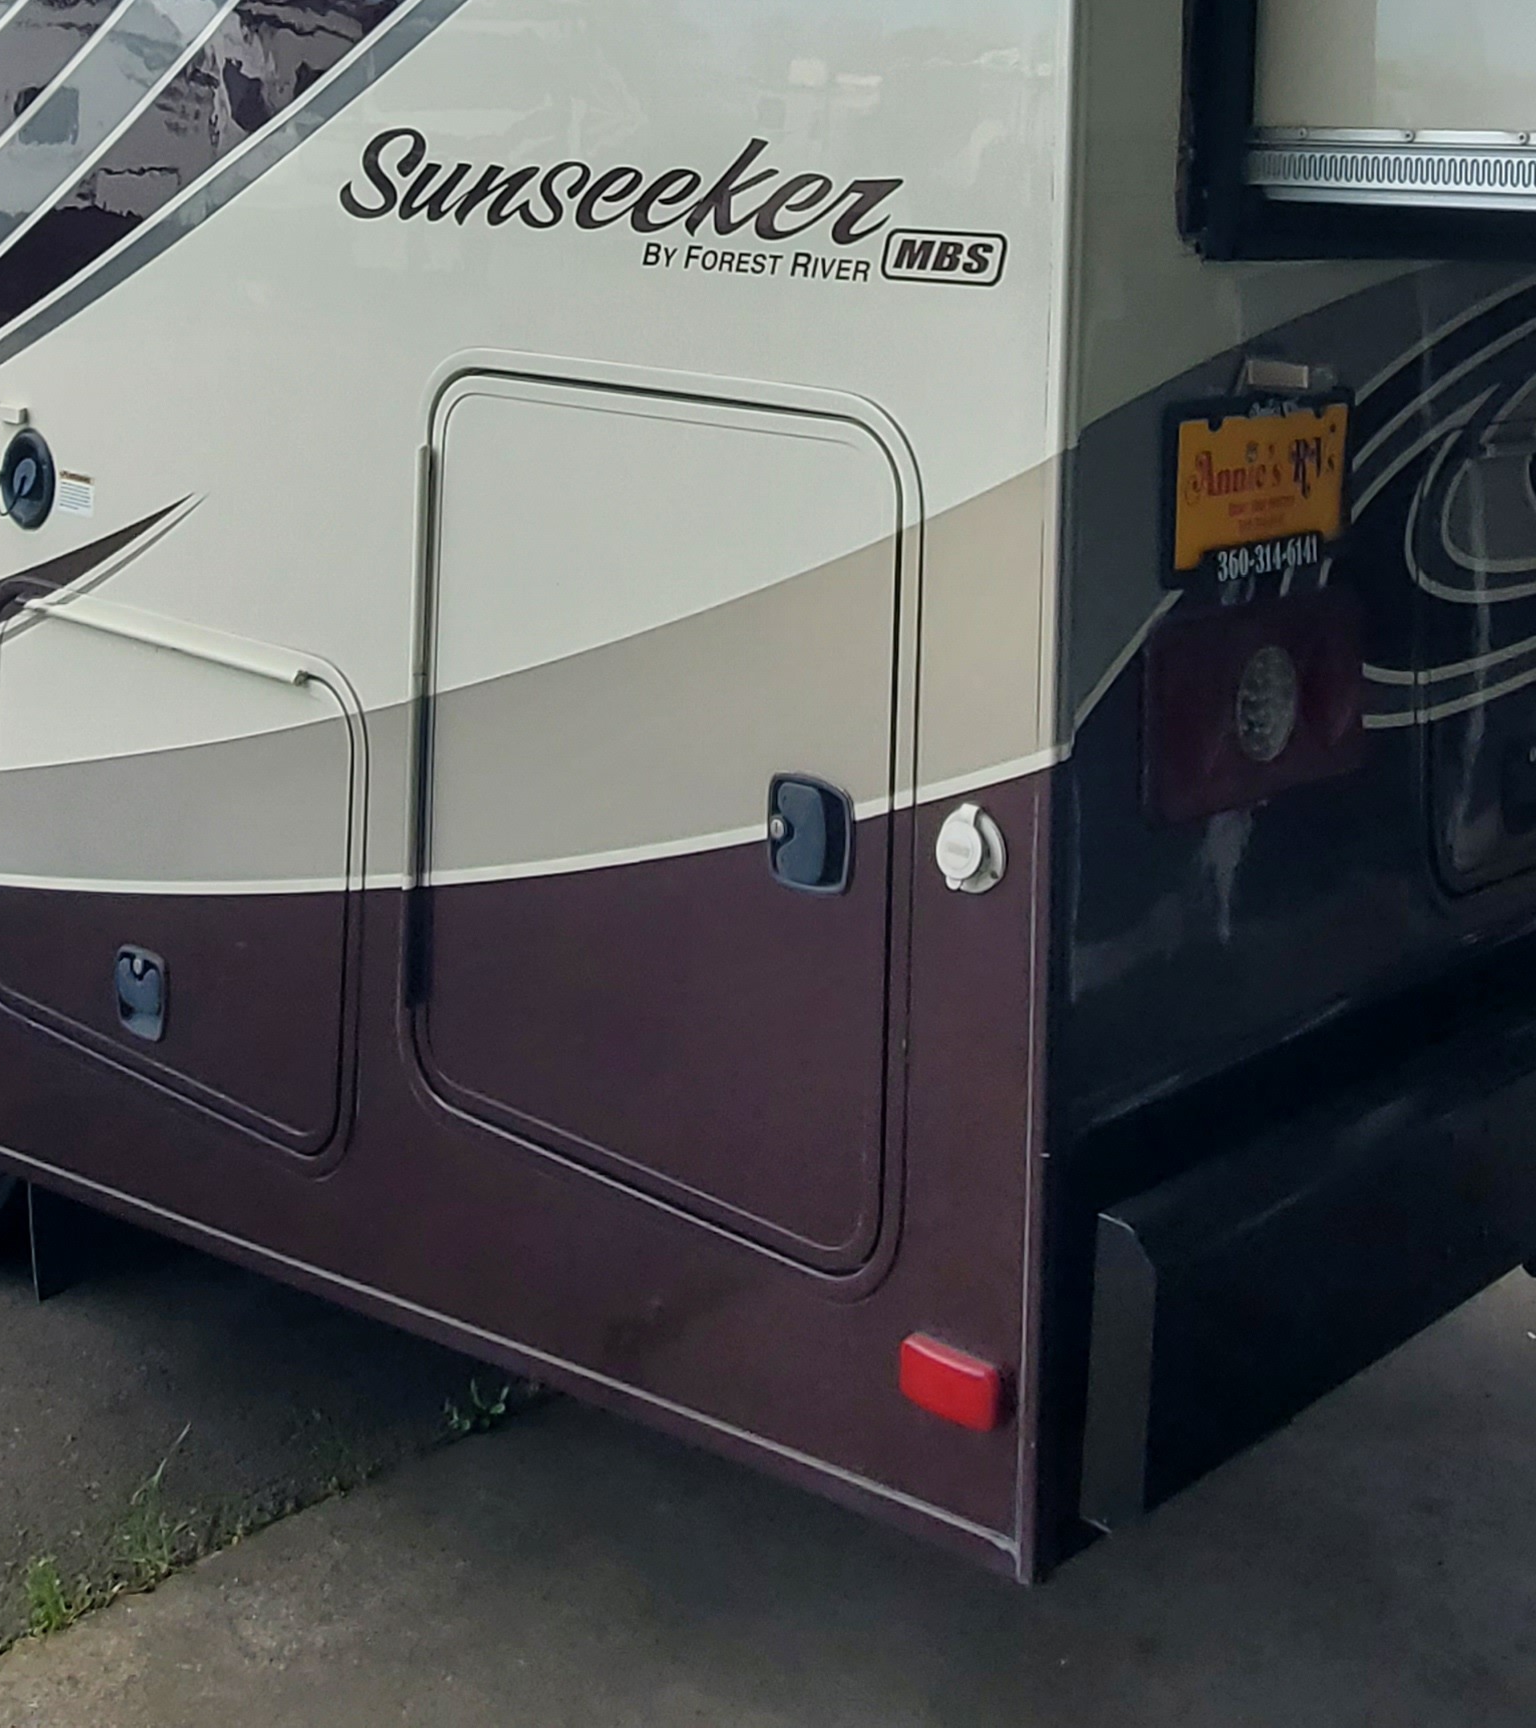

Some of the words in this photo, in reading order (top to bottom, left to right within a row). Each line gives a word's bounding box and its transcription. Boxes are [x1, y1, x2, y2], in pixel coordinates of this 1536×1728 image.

[340, 127, 904, 245] Sunseeker
[642, 242, 678, 267] BY
[684, 245, 783, 276] FOREST
[790, 252, 871, 282] RIVER
[893, 239, 994, 274] MBS
[1217, 535, 1318, 582] 360-314-6141
